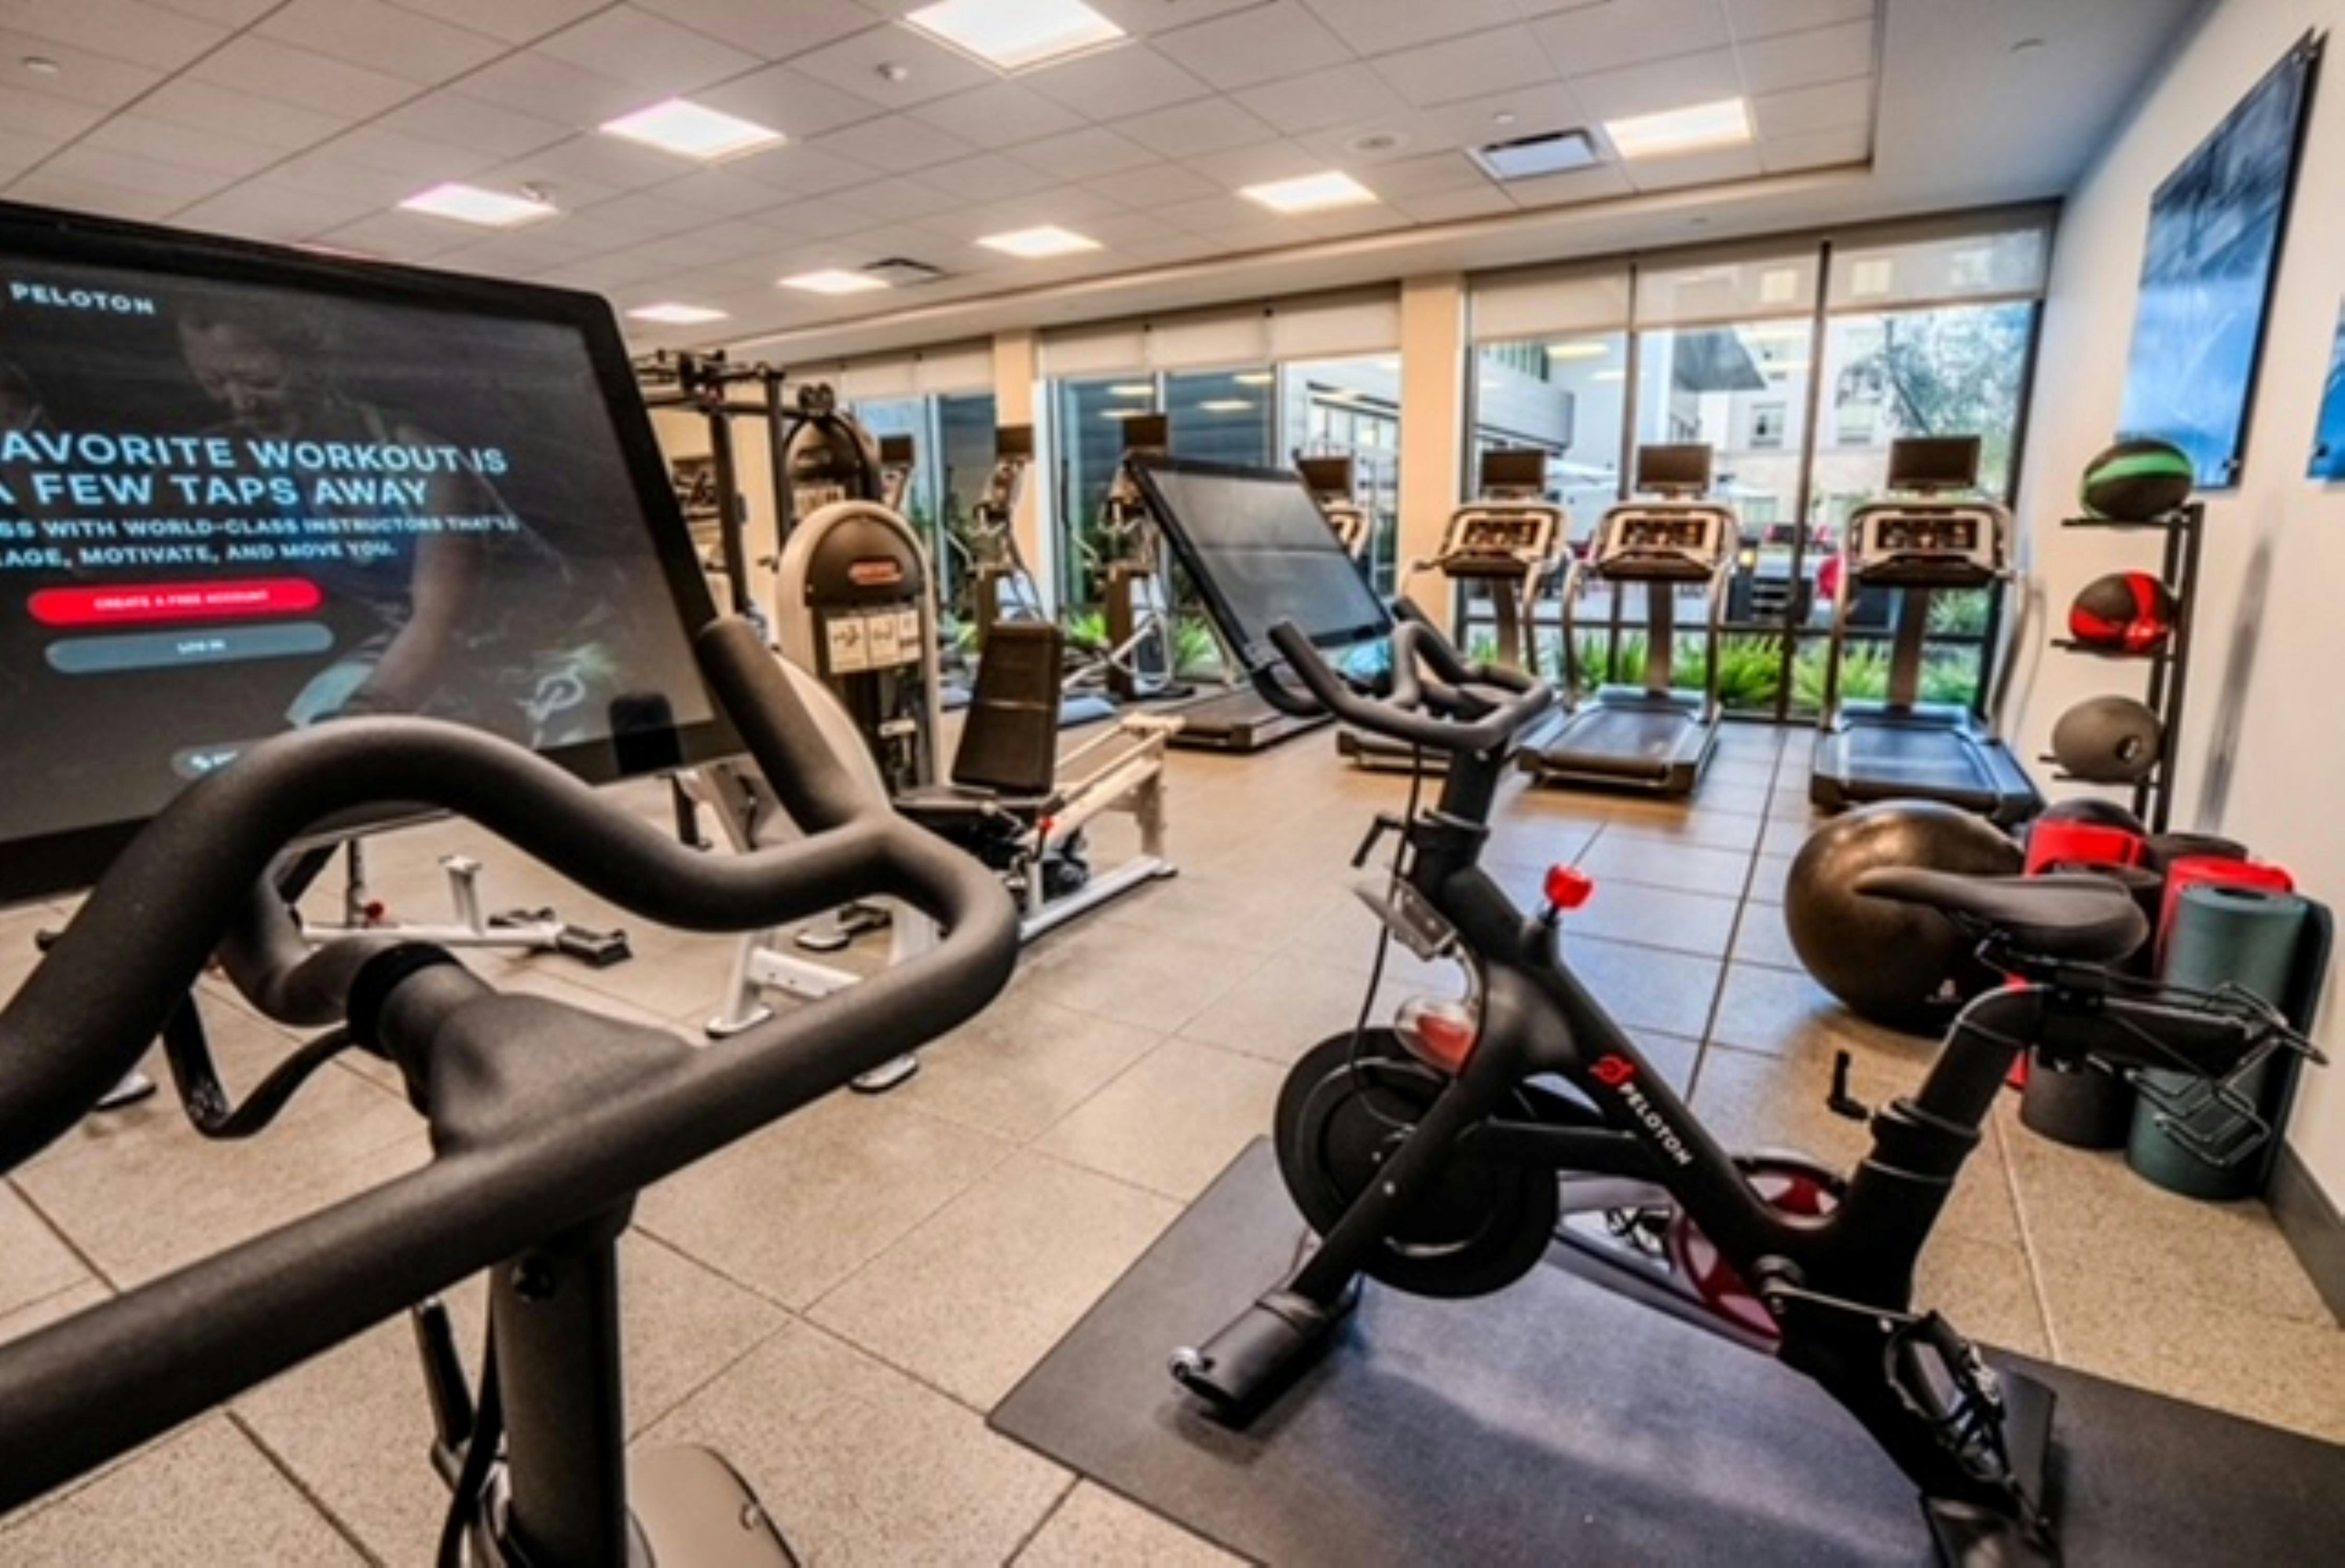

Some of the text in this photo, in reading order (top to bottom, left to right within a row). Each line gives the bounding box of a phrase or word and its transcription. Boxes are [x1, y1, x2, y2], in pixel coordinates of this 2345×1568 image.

[9, 282, 155, 315] PELOTON
[246, 439, 461, 472] WORKOUT
[470, 448, 509, 474] IS
[31, 472, 153, 505] FEW
[169, 474, 299, 506] TAPS
[316, 477, 428, 506] AWAY
[41, 519, 116, 538] WITH
[0, 547, 73, 568] AGE,
[225, 542, 274, 561] AND
[280, 542, 343, 560] MOVE
[1618, 1080, 1693, 1166] PELOTON
